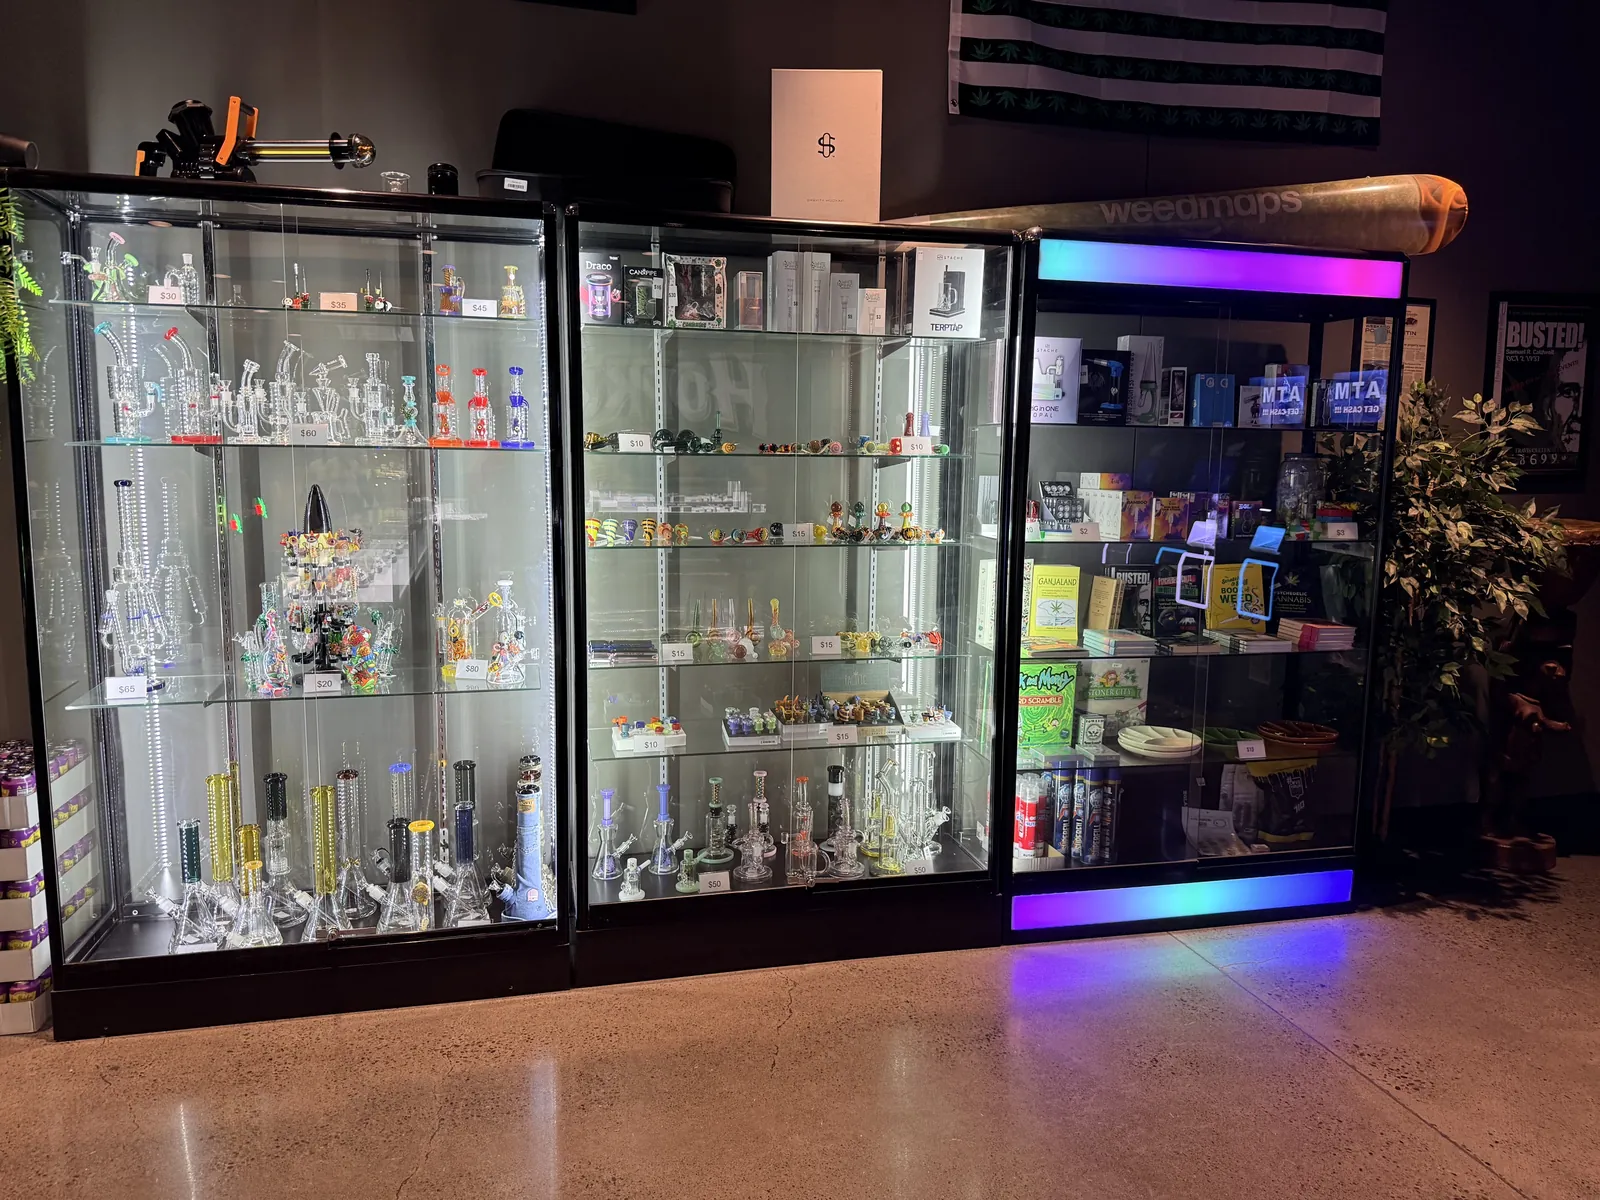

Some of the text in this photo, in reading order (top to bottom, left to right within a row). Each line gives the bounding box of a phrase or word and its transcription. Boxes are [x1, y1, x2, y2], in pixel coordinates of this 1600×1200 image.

[1100, 189, 1302, 224] weedmaps
[585, 261, 612, 271] Draco
[160, 292, 177, 300] $30
[331, 301, 347, 309] $35
[472, 304, 487, 312] $45
[930, 323, 963, 332] TERPTAP
[1506, 321, 1585, 348] BUSTED!
[300, 429, 317, 437] $60
[1038, 577, 1077, 586] GANJALAND
[820, 641, 833, 649] $15
[465, 665, 480, 673] $80
[317, 679, 333, 687] $20
[118, 684, 135, 693] $65
[1088, 688, 1115, 696] STONER
[644, 740, 658, 749] $10
[708, 880, 721, 888] $50
